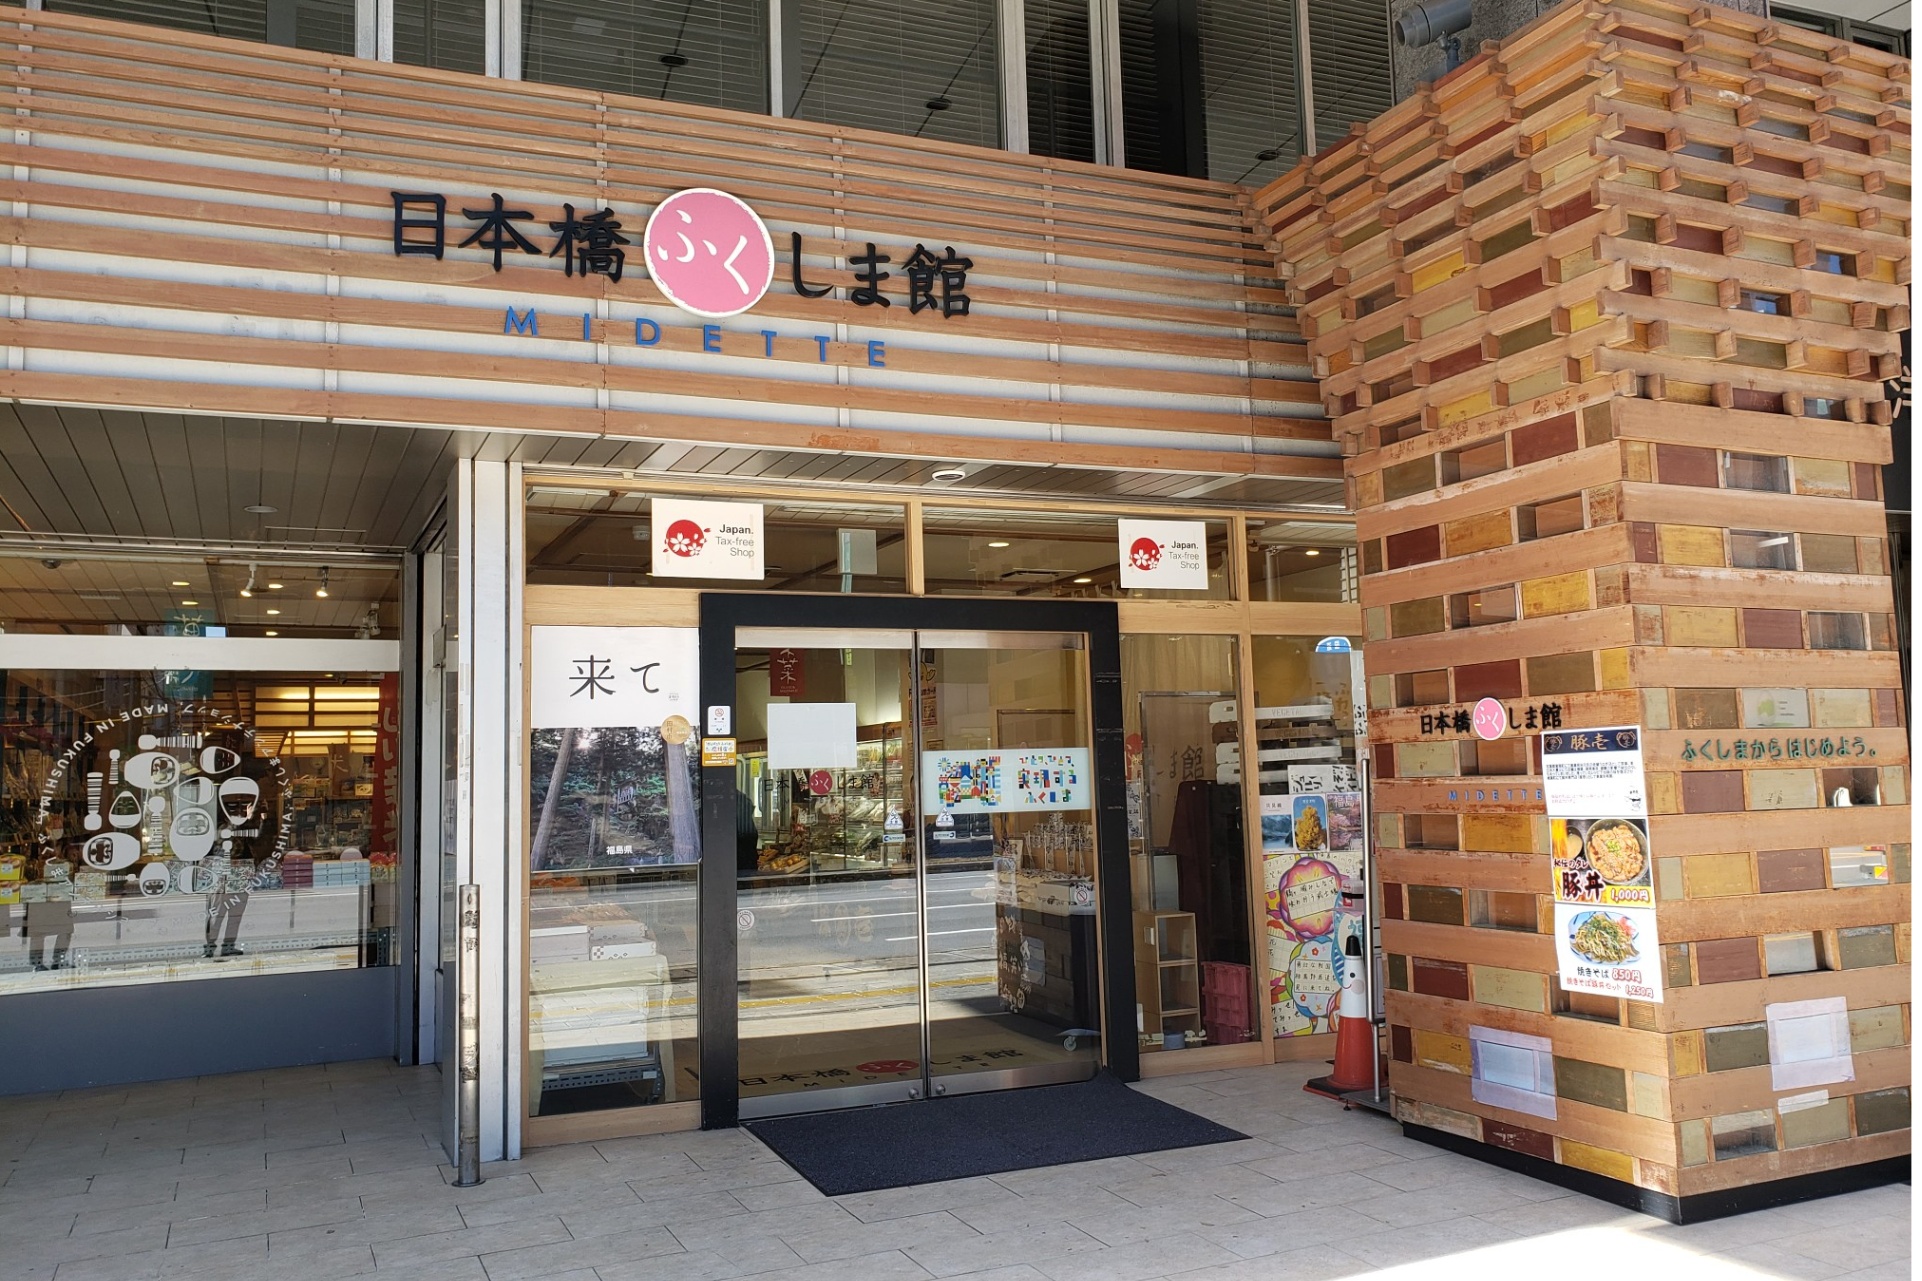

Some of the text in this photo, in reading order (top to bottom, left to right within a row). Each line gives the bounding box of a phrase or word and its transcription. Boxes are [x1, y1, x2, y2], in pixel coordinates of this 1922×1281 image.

[391, 190, 973, 319] 日本橋ふくしま館
[504, 305, 888, 367] MIDETTE
[719, 524, 754, 535] Japan.
[715, 536, 754, 546] Tax-free
[1171, 540, 1199, 550] Japan.
[730, 547, 754, 557] Shop
[1168, 551, 1199, 560] Tax-free
[1180, 560, 1199, 570] Shop
[568, 654, 661, 700] 来て
[119, 703, 169, 722] MADE
[1420, 699, 1562, 735] 日本橋ふくしま館
[98, 718, 115, 734] IN
[1018, 769, 1077, 789] 実現する
[1025, 789, 1072, 804] ふくしま
[1449, 789, 1542, 801] MIDETTE
[606, 845, 633, 855] 福島県
[1561, 870, 1604, 901] 豚丼
[224, 895, 241, 910] IN
[1611, 889, 1650, 902] 1,000円
[1577, 967, 1641, 983] 焼きそば 850円
[1625, 985, 1654, 998] 1,250円
[803, 1062, 989, 1088] MIDETE
